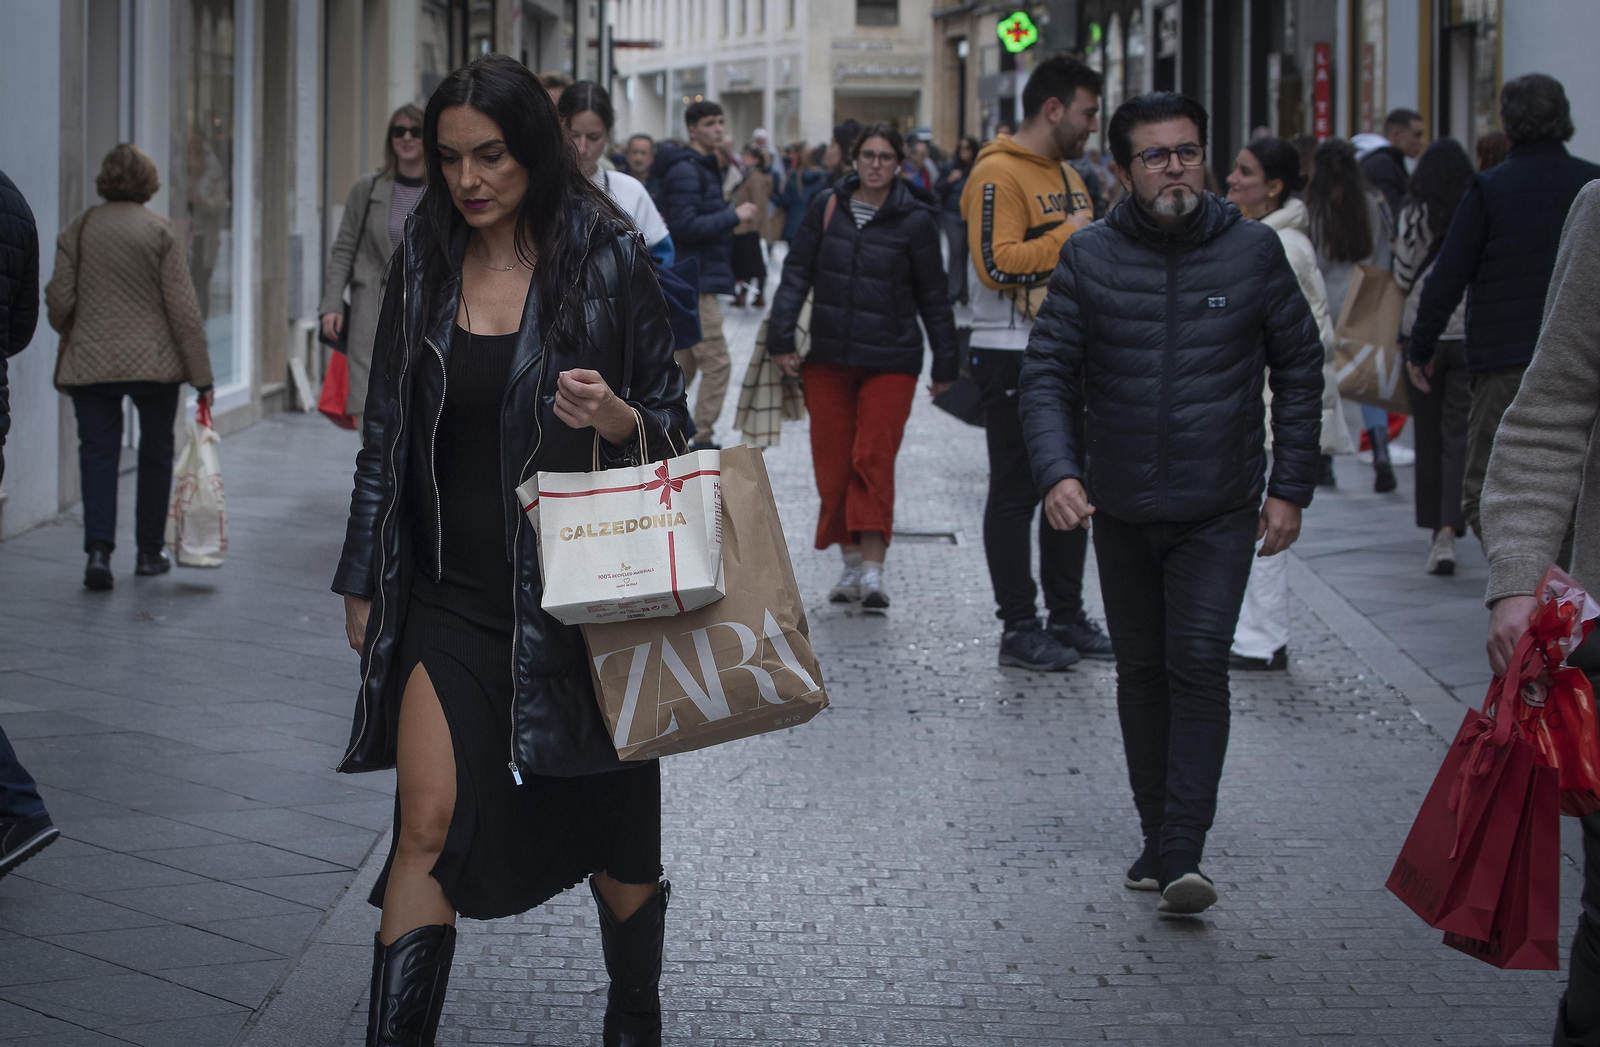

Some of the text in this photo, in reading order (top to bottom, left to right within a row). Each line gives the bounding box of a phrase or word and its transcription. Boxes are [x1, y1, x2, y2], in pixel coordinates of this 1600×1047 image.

[1316, 51, 1328, 81] LA
[560, 511, 687, 542] CALZEDONIA
[612, 571, 633, 579] RECYCLED
[593, 607, 820, 750] ZARA
